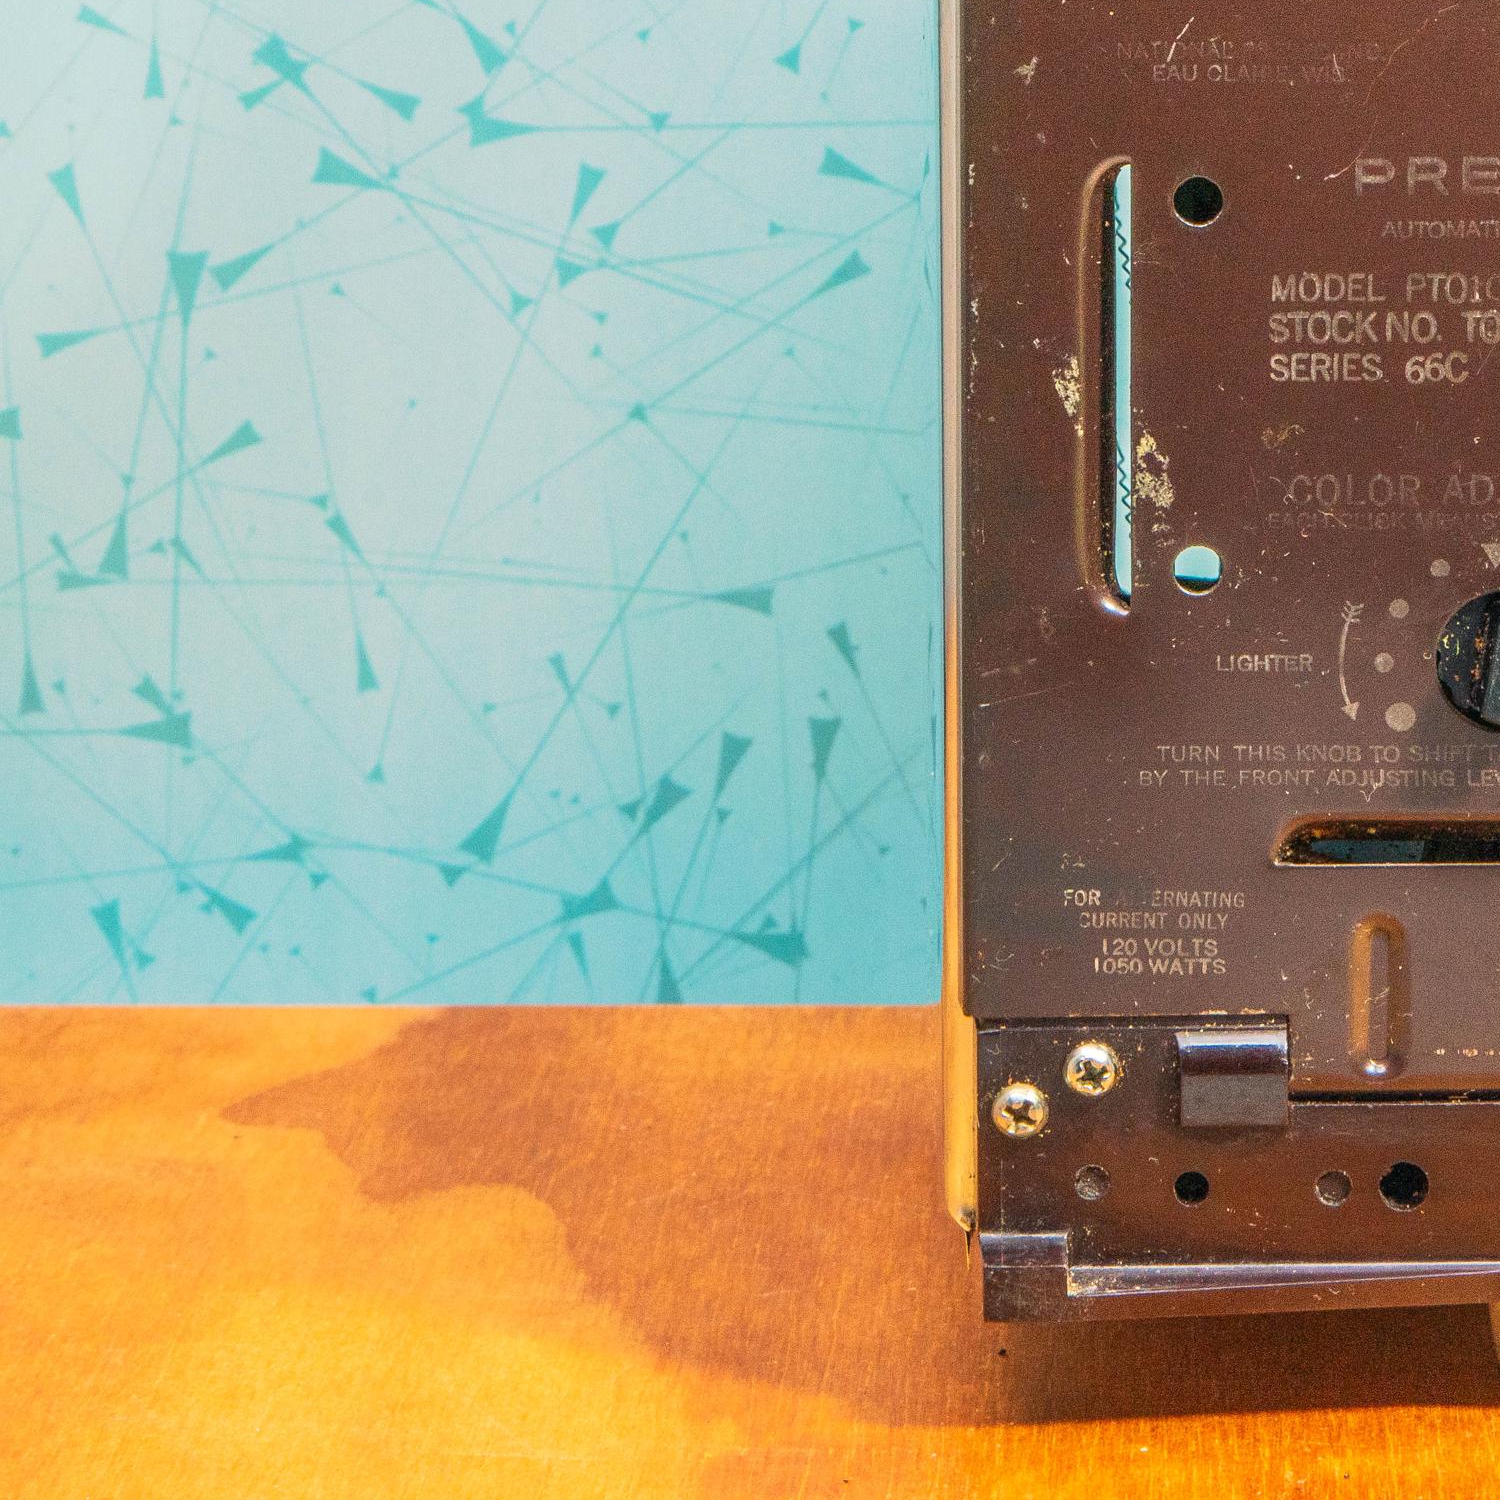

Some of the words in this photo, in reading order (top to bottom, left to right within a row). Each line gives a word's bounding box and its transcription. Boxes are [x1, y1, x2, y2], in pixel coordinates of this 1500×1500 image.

[1152, 63, 1199, 83] EAU
[1271, 271, 1386, 302] MODEL
[1268, 310, 1379, 343] STOCK
[1385, 311, 1442, 344] NO.
[1404, 350, 1470, 385] 66C
[1288, 473, 1422, 506] COLOR
[1216, 653, 1315, 674] LIGHTER
[1156, 745, 1220, 763] TURN
[1233, 744, 1286, 763] THIS
[1296, 744, 1362, 763] KNOB
[1370, 746, 1400, 763] TO
[1409, 745, 1473, 762] SHIFT
[1138, 770, 1168, 788] BY
[1178, 770, 1226, 787] THE
[1239, 769, 1315, 787] FRONT
[1325, 769, 1455, 788] ADJUSTING
[1063, 888, 1101, 907] FOR
[1079, 911, 1168, 929] CURRENT
[1177, 912, 1229, 930] ONLY
[1102, 937, 1138, 957] 120
[1143, 938, 1219, 957] VOLTS
[1093, 956, 1144, 975] 1050
[1148, 957, 1227, 976] WATTS
